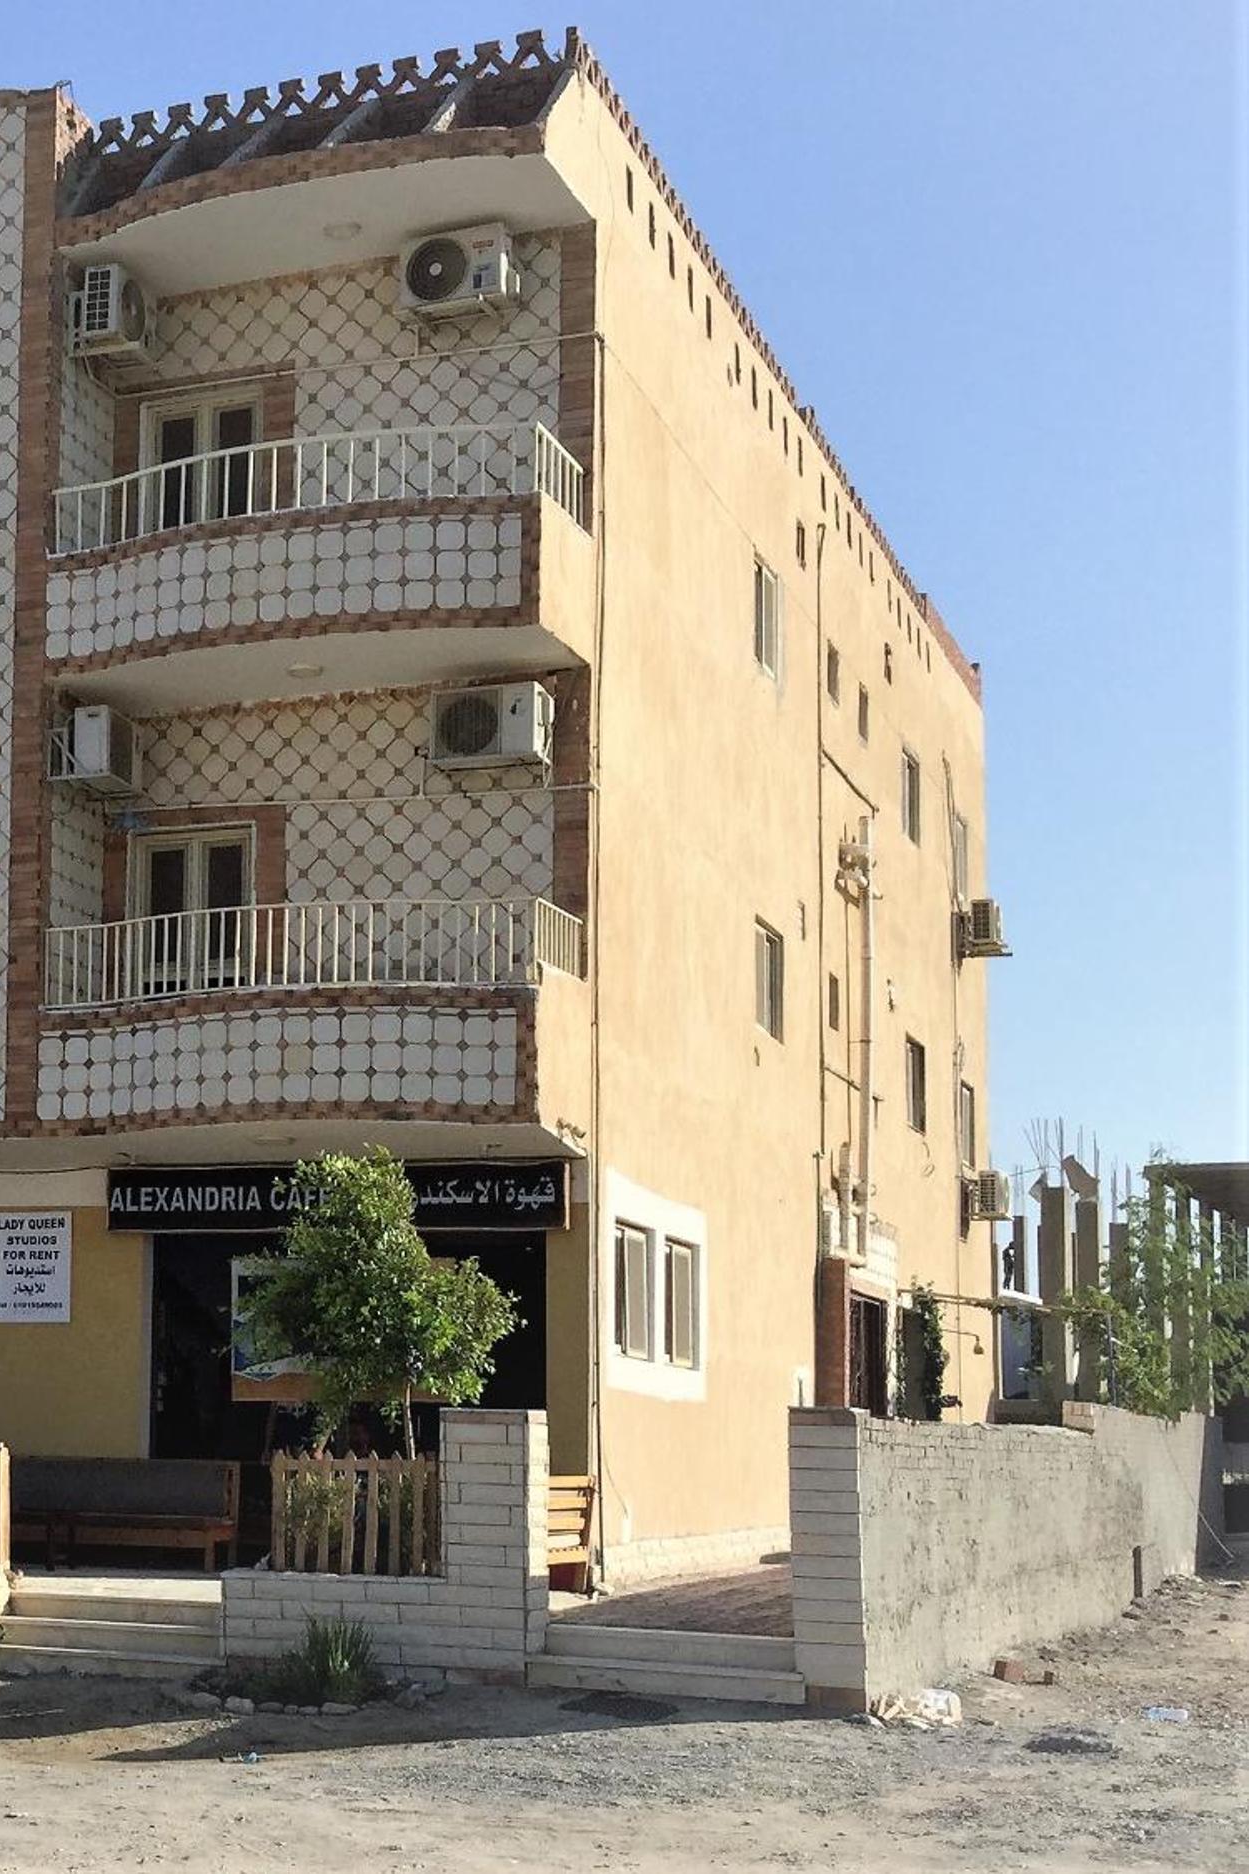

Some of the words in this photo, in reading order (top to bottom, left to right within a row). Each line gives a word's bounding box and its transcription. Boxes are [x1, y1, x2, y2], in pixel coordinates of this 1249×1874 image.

[110, 1186, 262, 1212] ALEXANDRIA
[411, 1180, 501, 1207] الاسكندر
[505, 1177, 556, 1210] قهوة
[28, 1217, 65, 1230] QUEEN
[6, 1235, 57, 1245] STUDIOS
[3, 1250, 26, 1260] FOR
[29, 1250, 60, 1260] RENT
